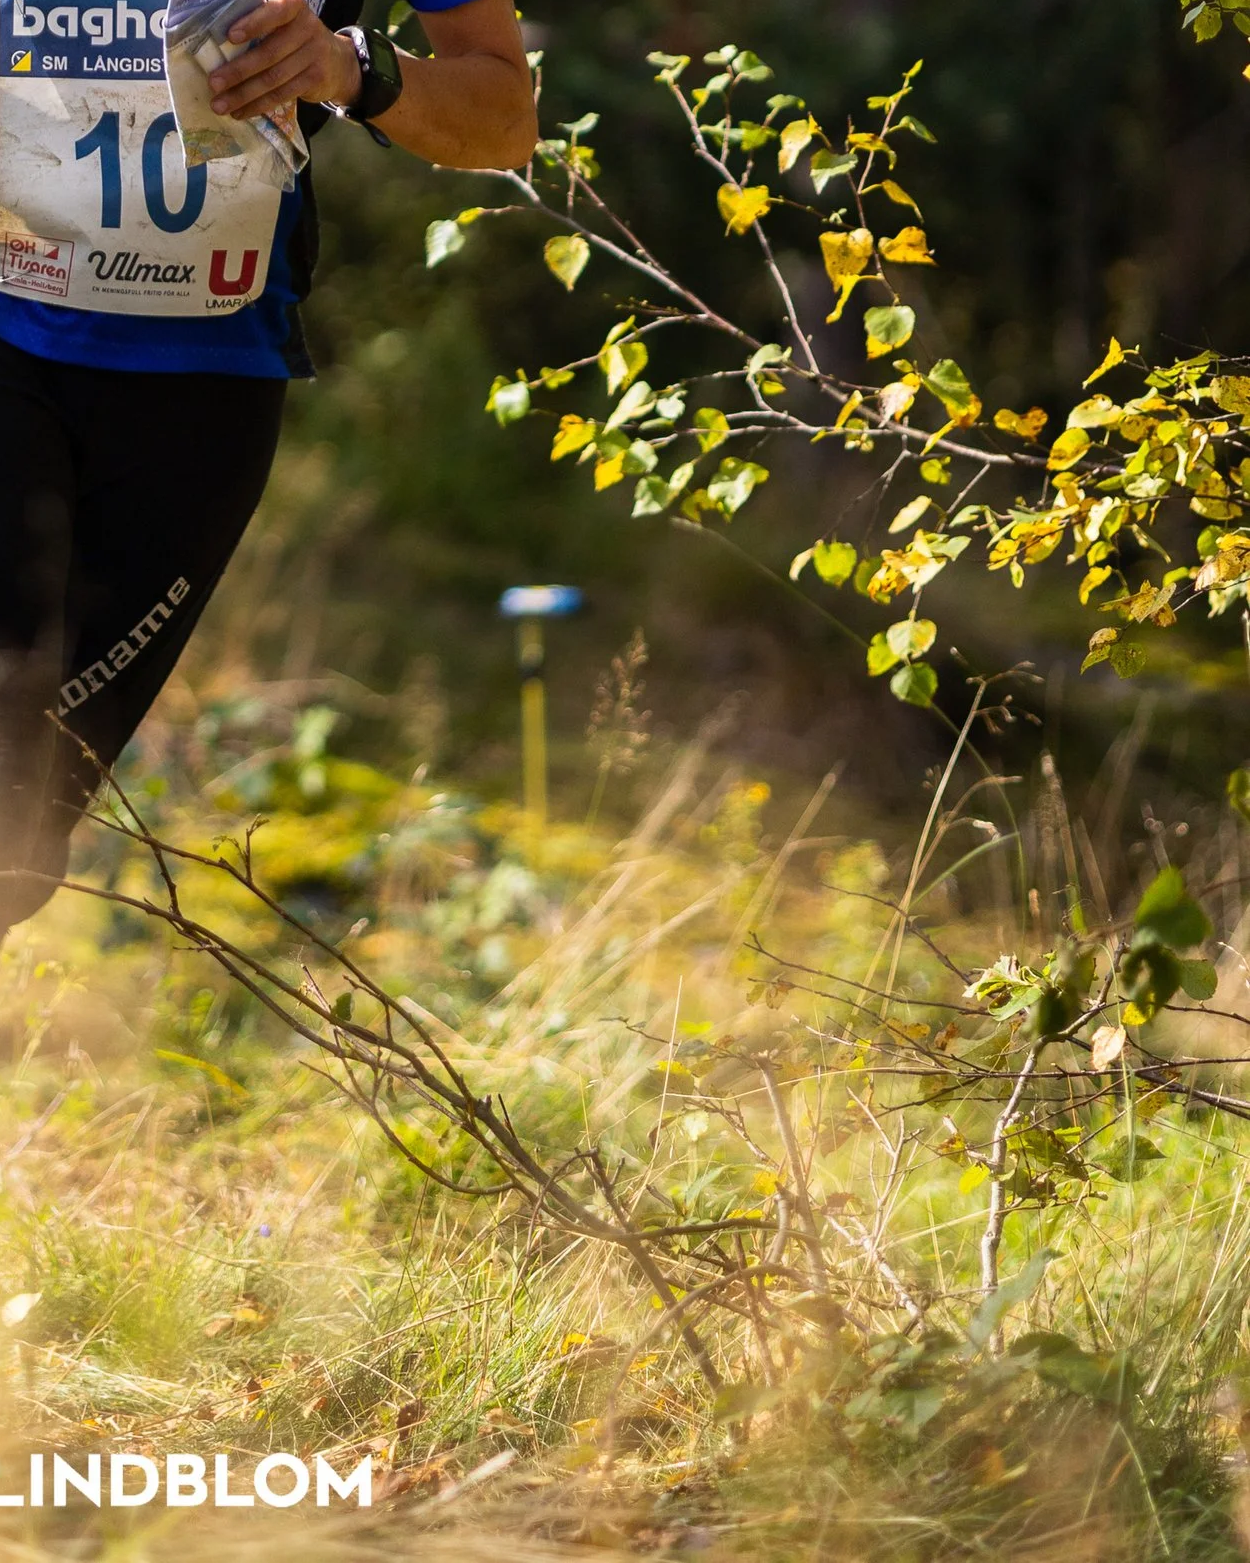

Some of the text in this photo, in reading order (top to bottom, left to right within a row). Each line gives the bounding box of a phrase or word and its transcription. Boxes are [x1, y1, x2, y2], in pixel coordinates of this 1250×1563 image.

[42, 55, 68, 71] SM
[75, 111, 208, 233] 10
[8, 252, 67, 280] Tisaren
[87, 250, 196, 284] Ullmax
